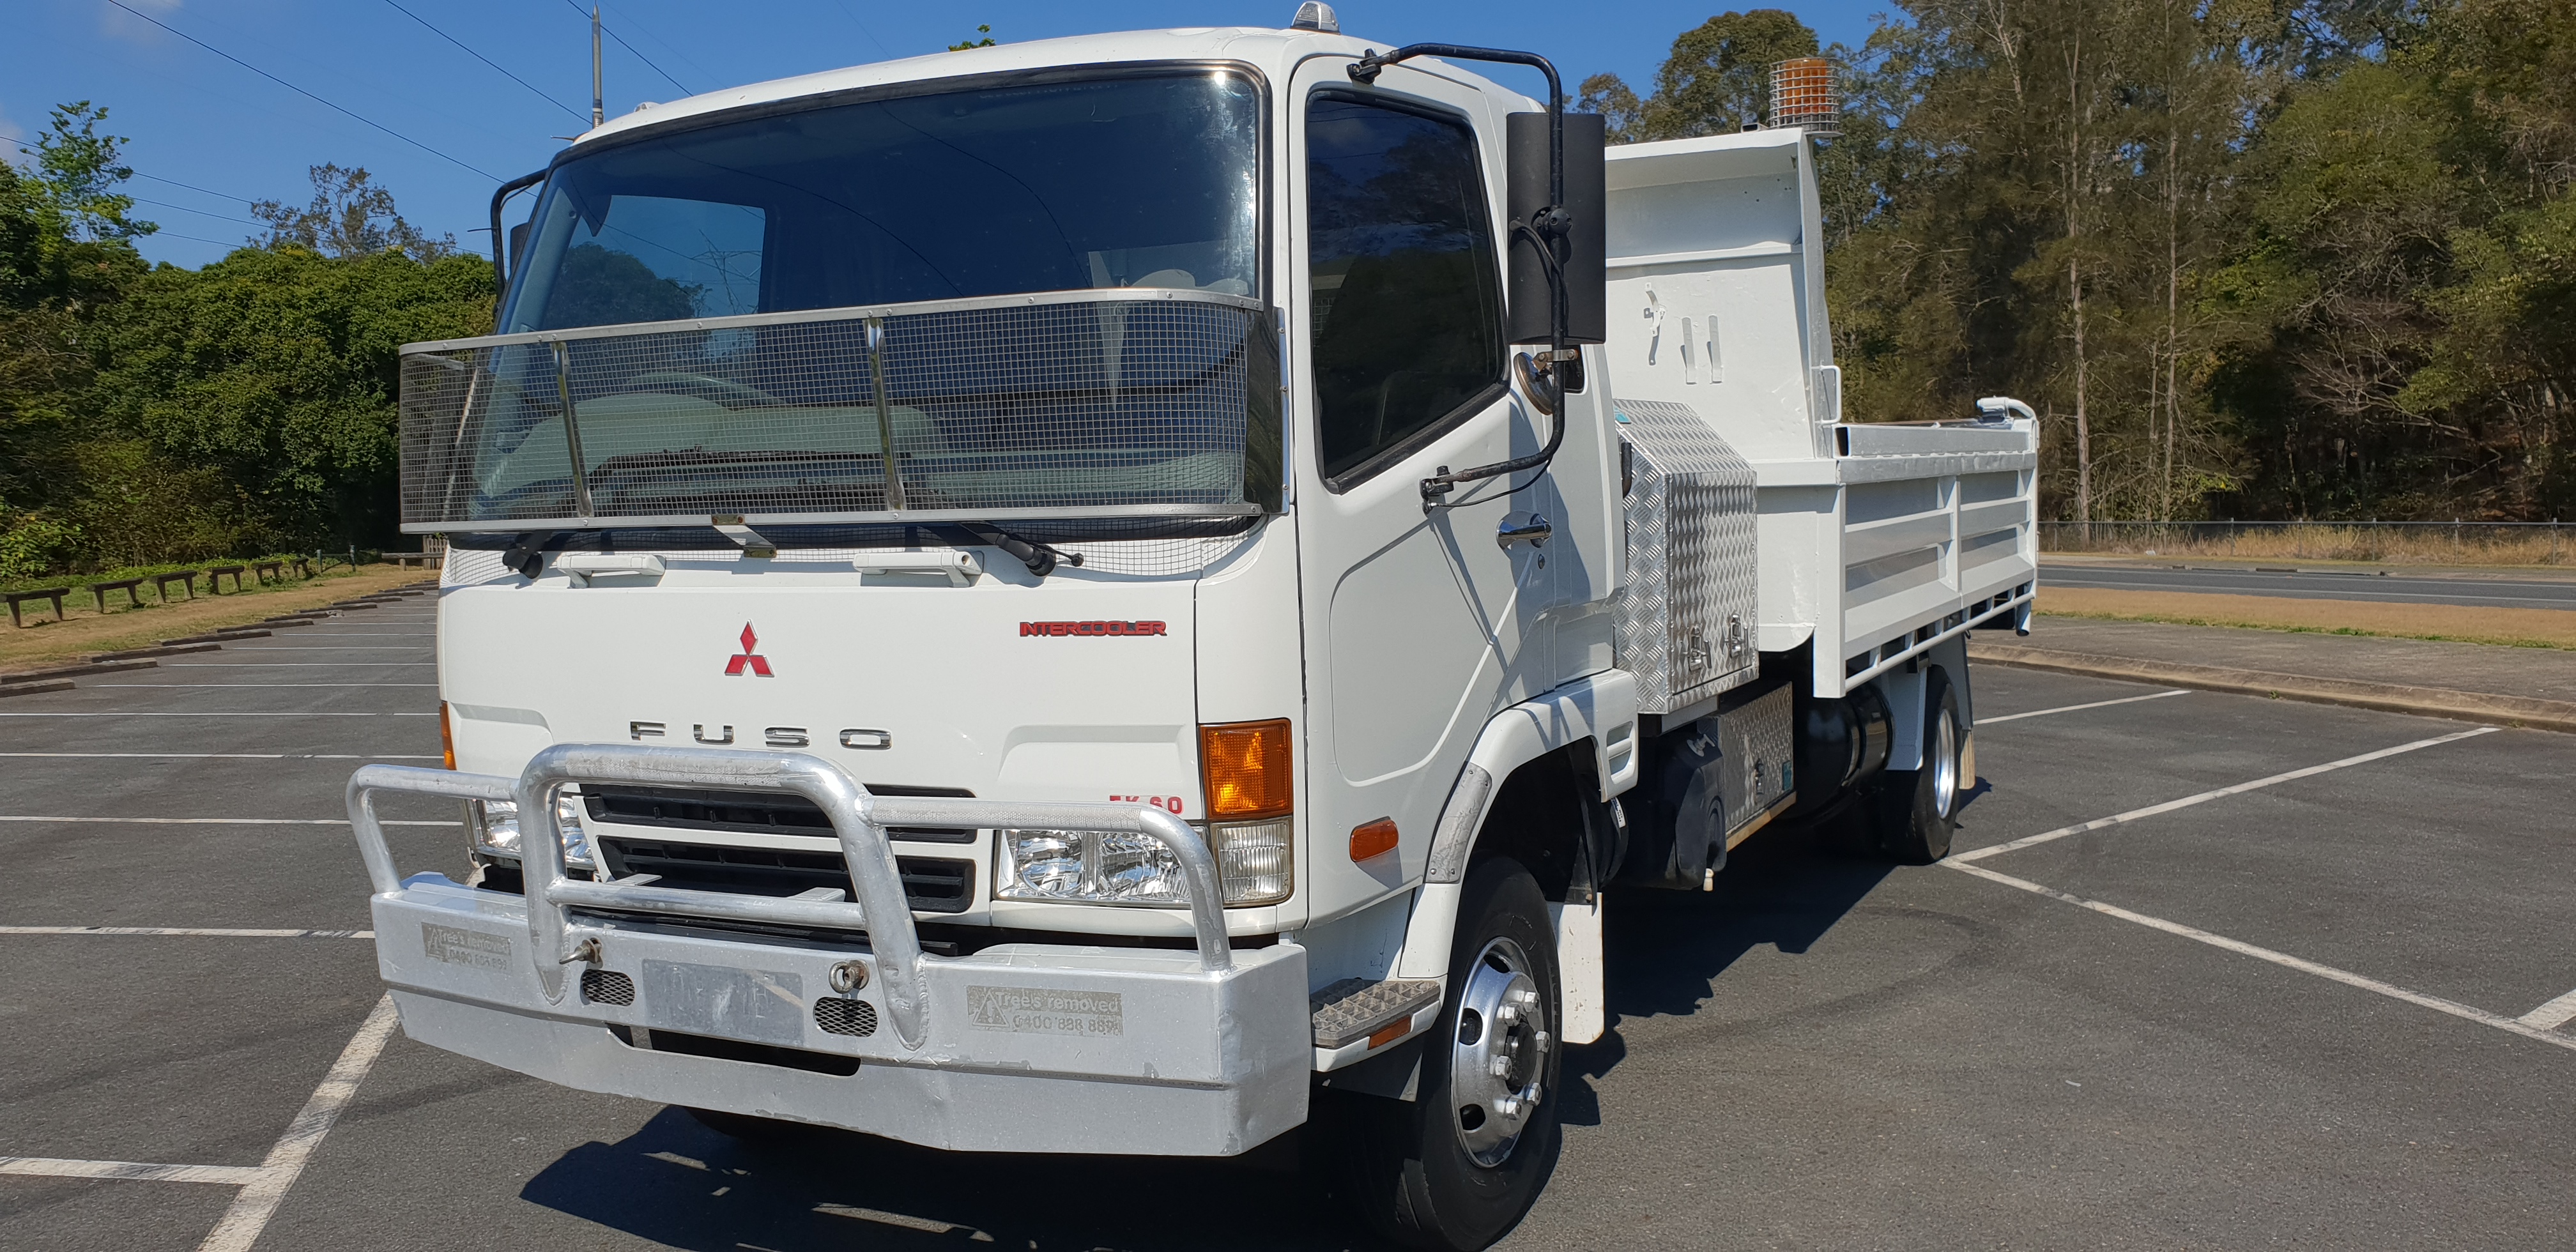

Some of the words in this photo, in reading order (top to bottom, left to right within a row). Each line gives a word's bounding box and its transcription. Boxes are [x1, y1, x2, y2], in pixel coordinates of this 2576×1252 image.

[1020, 621, 1167, 637] INTERCOOLER
[630, 720, 893, 751] FUSO
[1047, 997, 1119, 1012] removed
